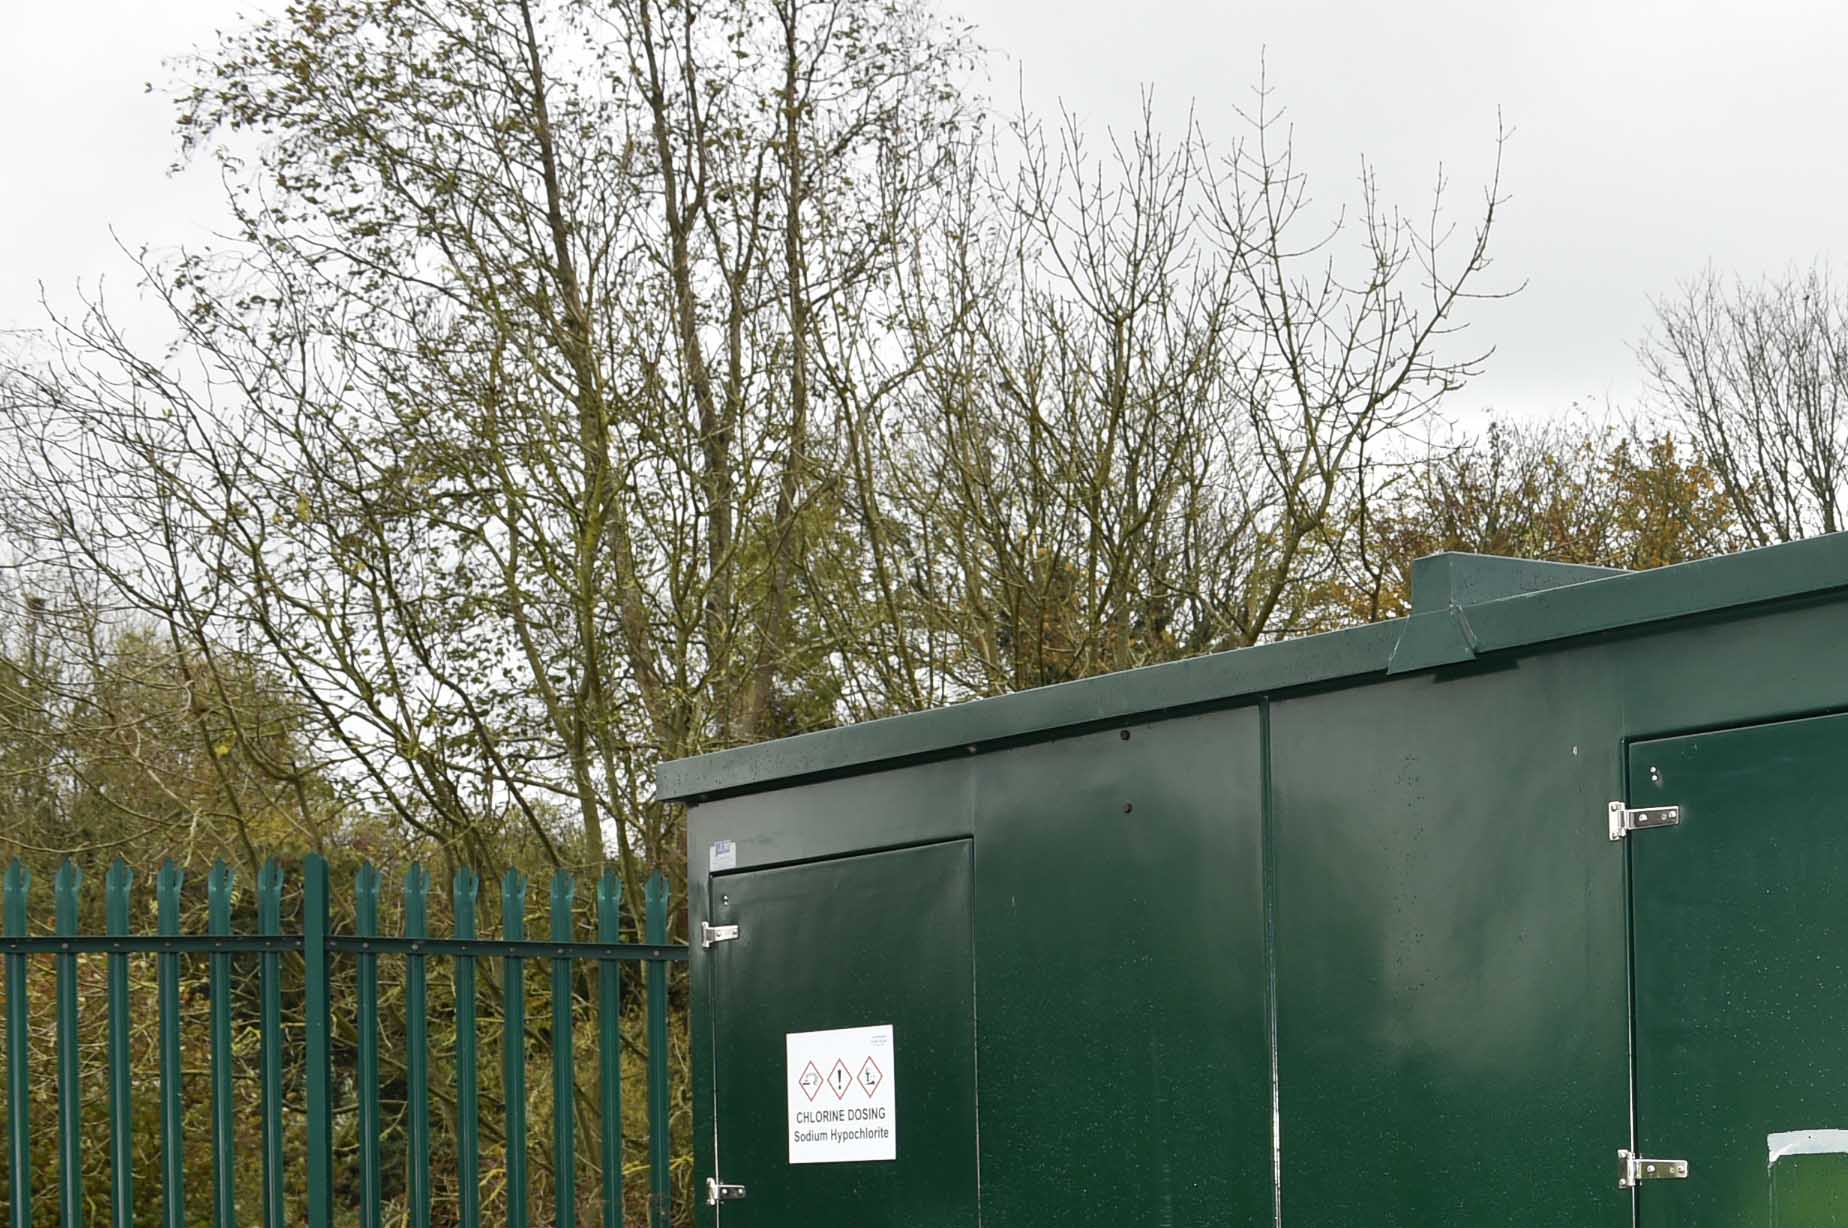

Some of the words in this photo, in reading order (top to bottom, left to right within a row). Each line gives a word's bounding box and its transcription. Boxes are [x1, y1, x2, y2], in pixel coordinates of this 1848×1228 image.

[796, 1109, 845, 1124] CHLORINE
[847, 1107, 886, 1121] DOSING
[794, 1129, 828, 1143] Sodium
[830, 1127, 889, 1144] Hypochlorite
